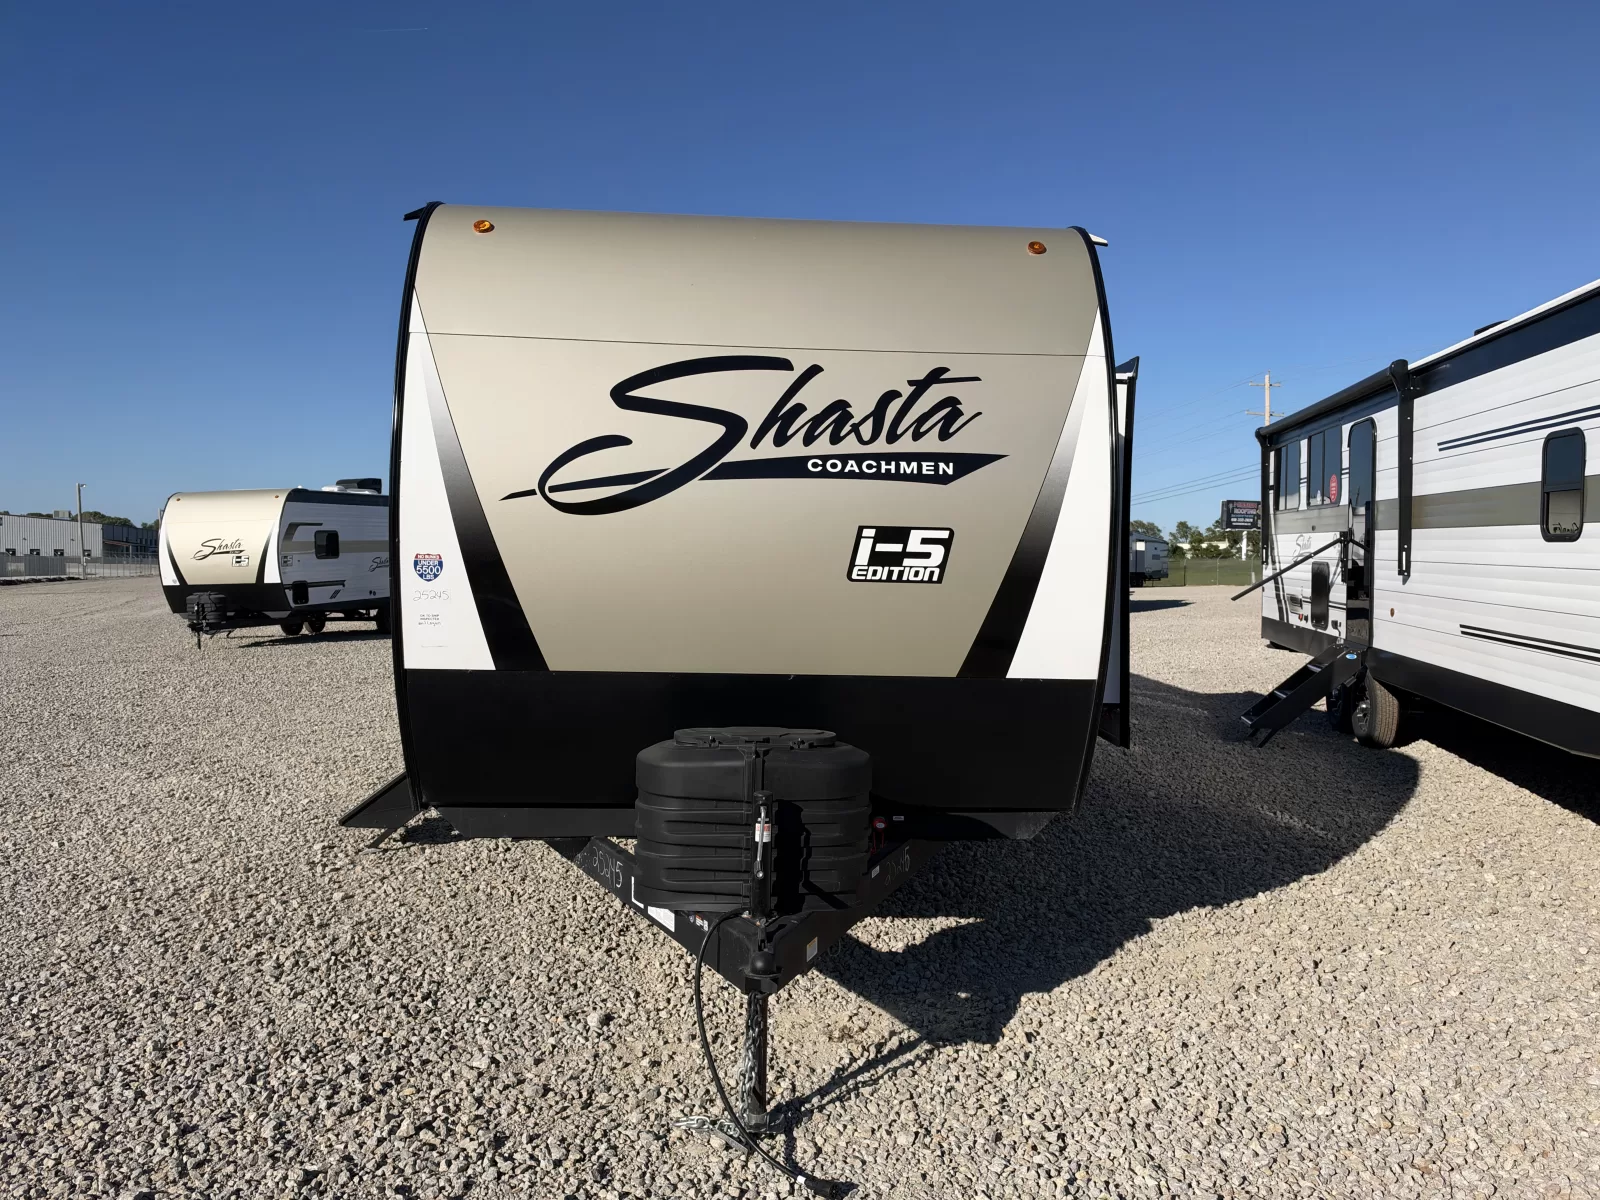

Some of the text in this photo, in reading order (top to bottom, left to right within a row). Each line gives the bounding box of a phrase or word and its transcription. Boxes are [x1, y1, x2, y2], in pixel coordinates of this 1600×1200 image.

[537, 355, 982, 515] Shasta
[807, 458, 956, 477] COACHMEN
[193, 538, 243, 561] Shasta
[416, 565, 441, 575] 5500
[852, 565, 941, 582] EDITION
[413, 590, 449, 601] 25245
